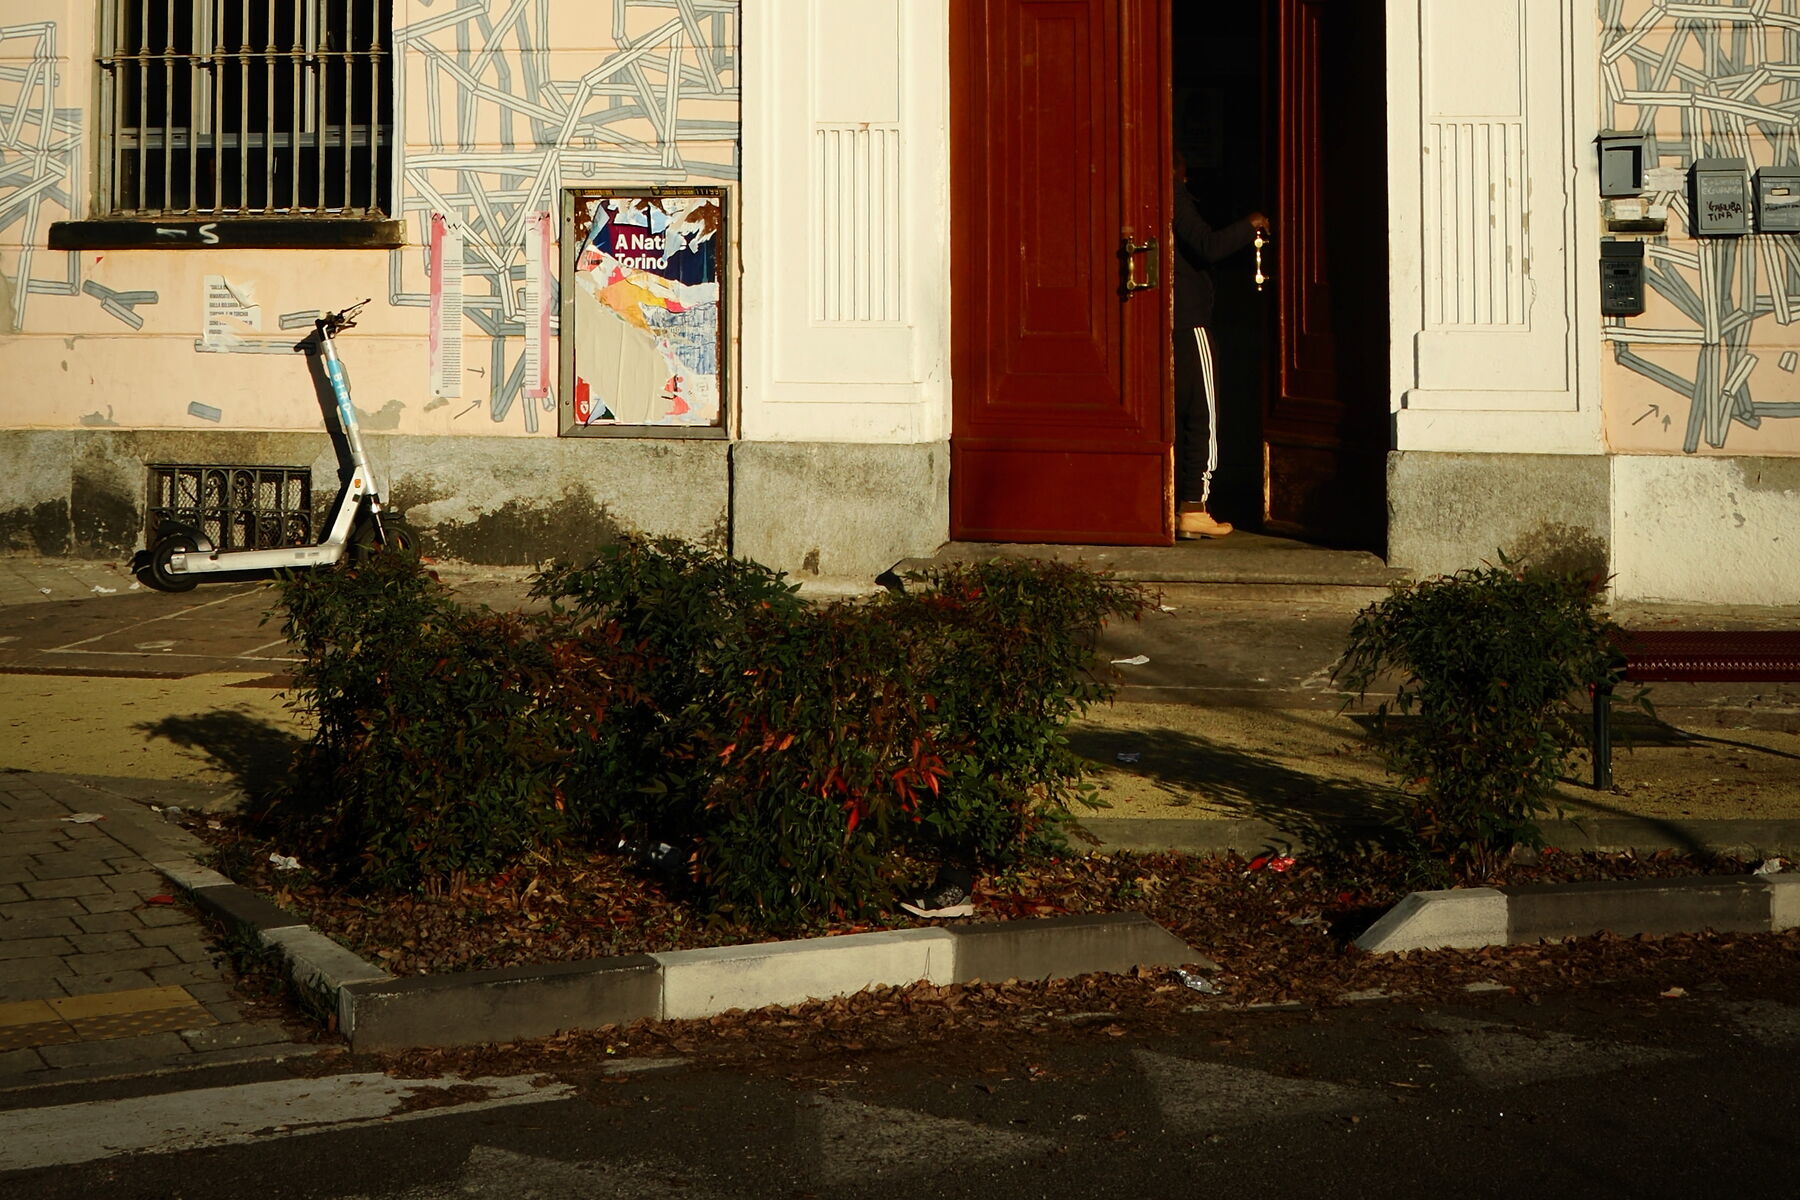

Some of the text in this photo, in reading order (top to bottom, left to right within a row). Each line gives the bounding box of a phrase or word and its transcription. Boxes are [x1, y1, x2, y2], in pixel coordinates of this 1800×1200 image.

[1707, 211, 1733, 222] TINA
[615, 234, 687, 250] A Nate
[615, 253, 668, 270] Torino
[333, 372, 351, 412] BIRD
